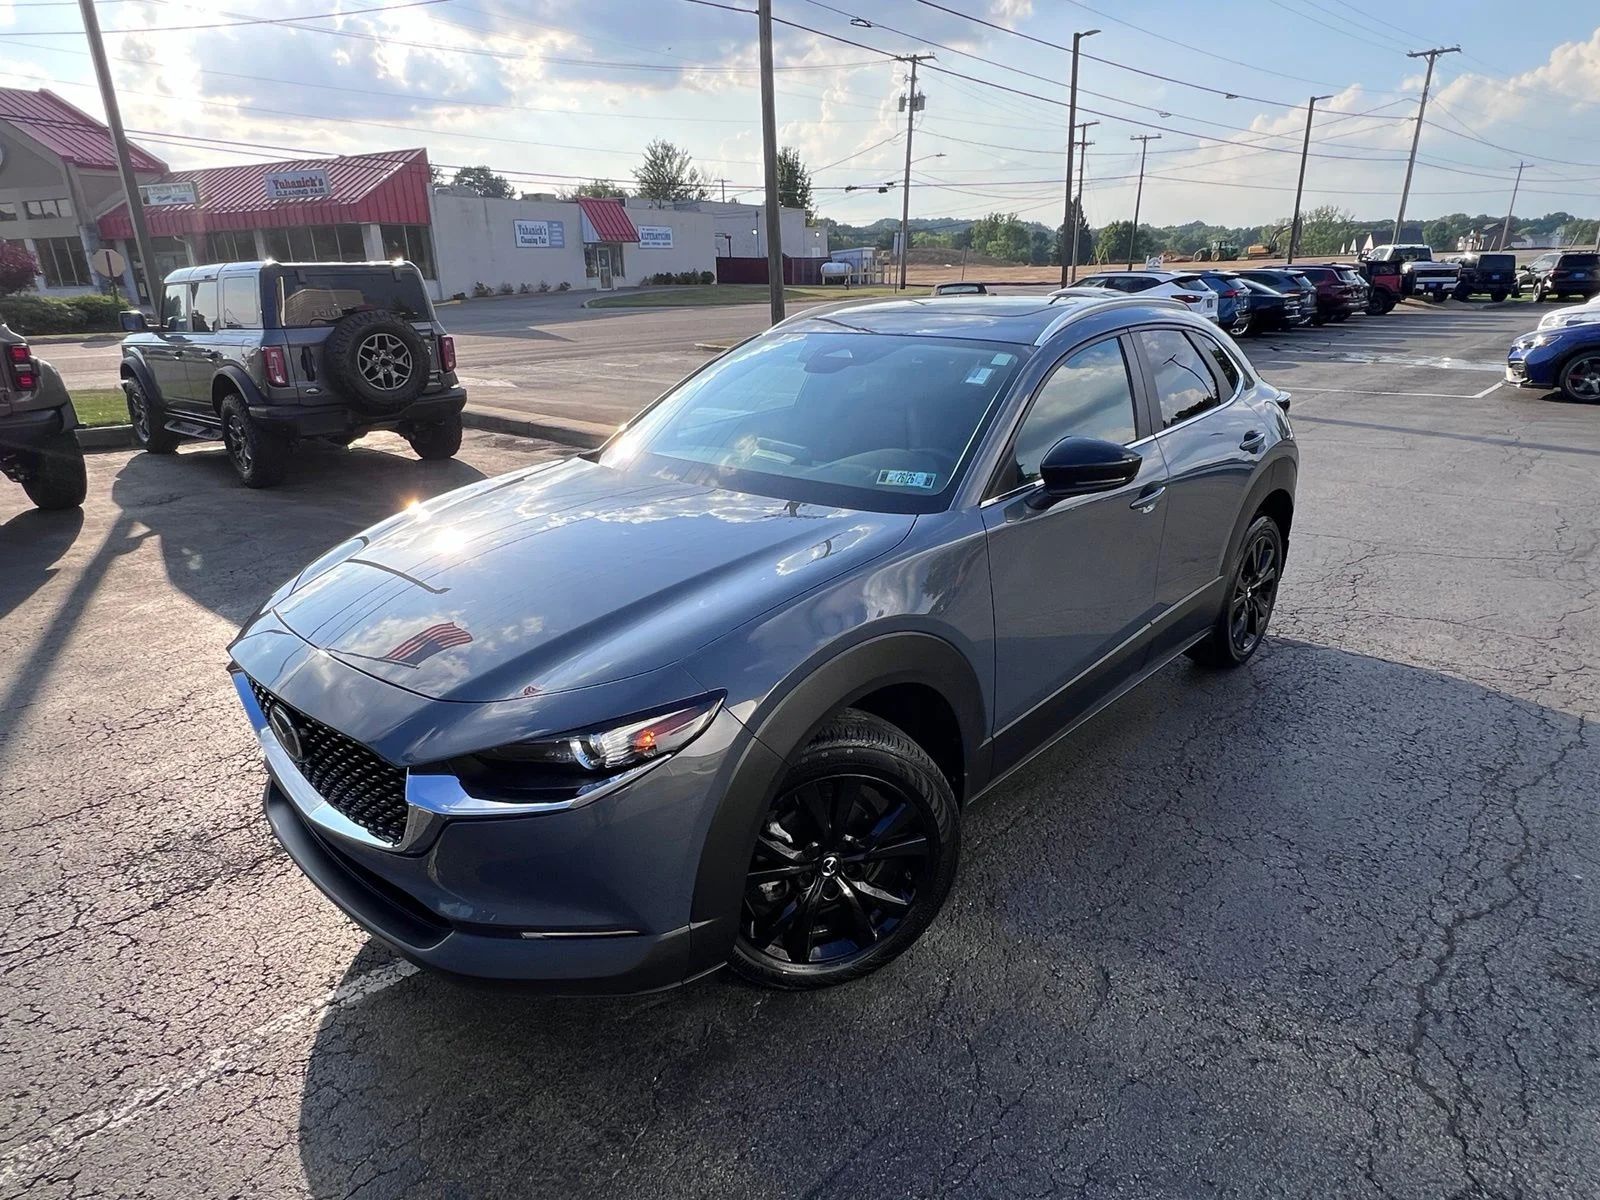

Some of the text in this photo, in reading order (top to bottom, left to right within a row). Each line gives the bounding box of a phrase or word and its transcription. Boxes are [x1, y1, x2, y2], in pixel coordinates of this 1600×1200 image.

[272, 176, 324, 190] Yuhanick's
[275, 187, 326, 197] CLEANING FAIR
